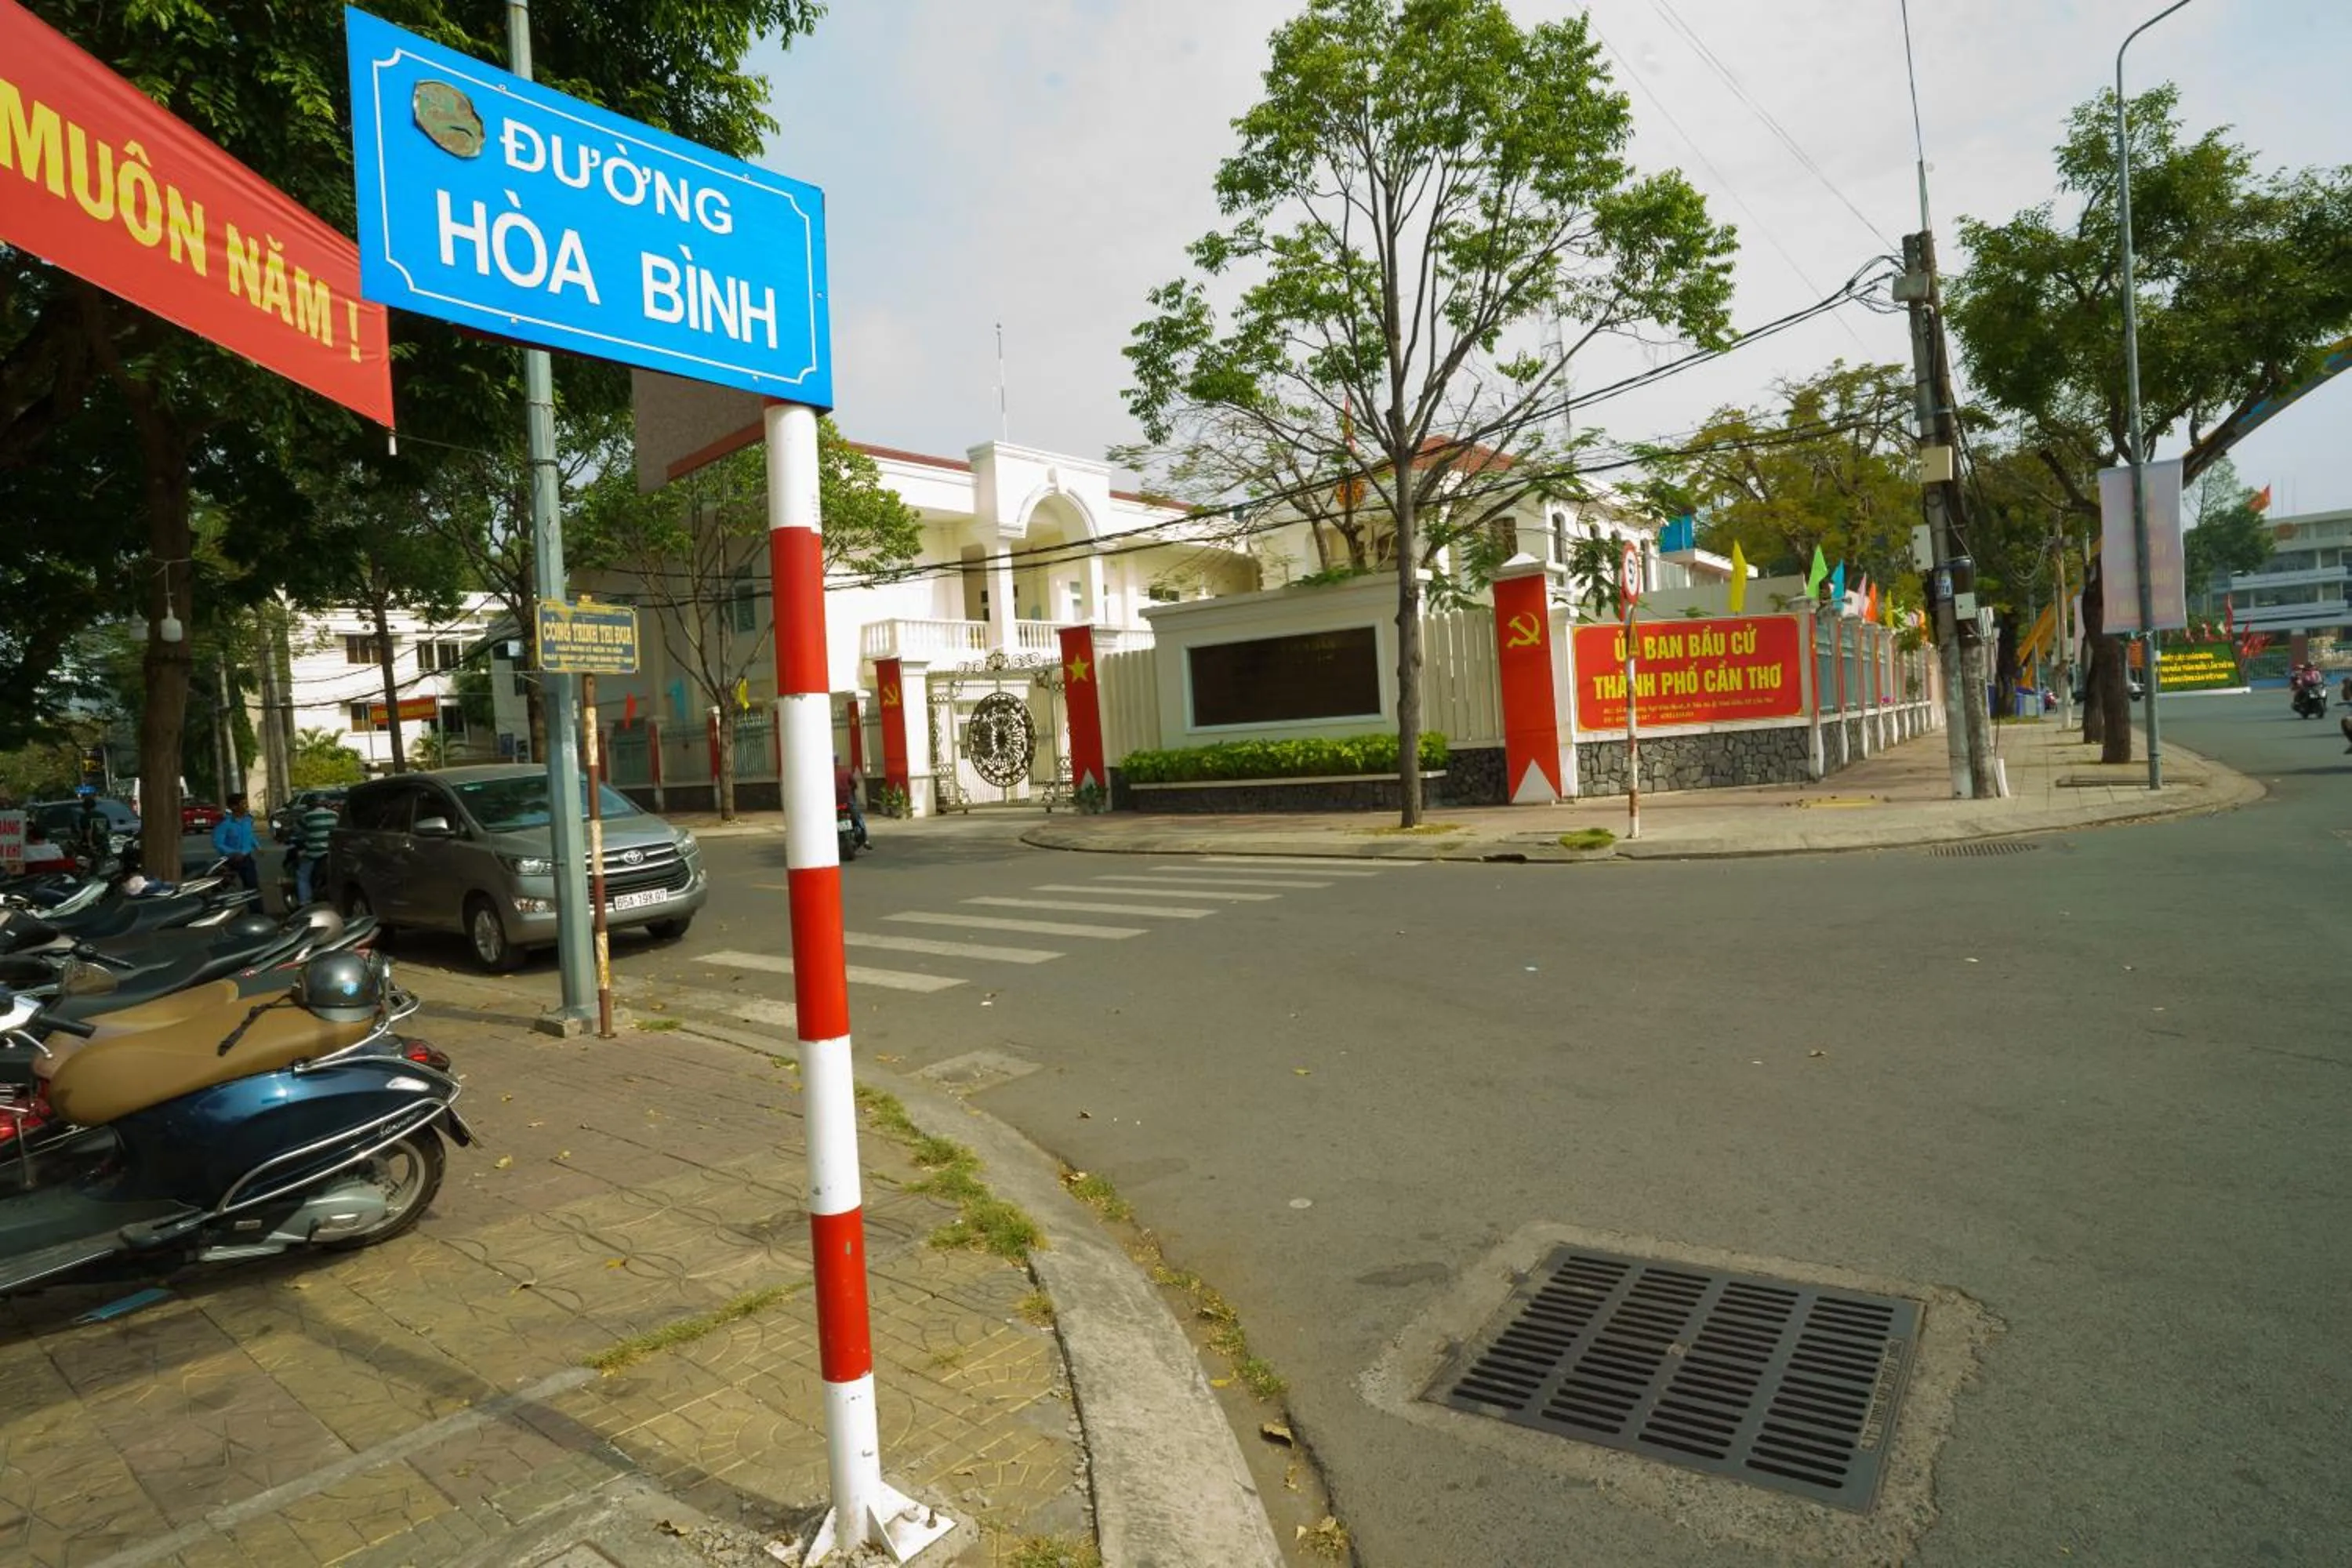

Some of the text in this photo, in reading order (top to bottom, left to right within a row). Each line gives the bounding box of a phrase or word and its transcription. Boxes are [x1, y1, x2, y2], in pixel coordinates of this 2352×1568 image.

[0, 79, 362, 364] MUÔN NĂM !
[499, 117, 734, 235] ĐƯỜNG
[437, 188, 779, 350] HÒA BÌNH
[1593, 659, 1783, 700] THÀNH PHỐ CẦN THƠ
[1643, 633, 1684, 662] BAN
[1730, 622, 1757, 655] CỬ
